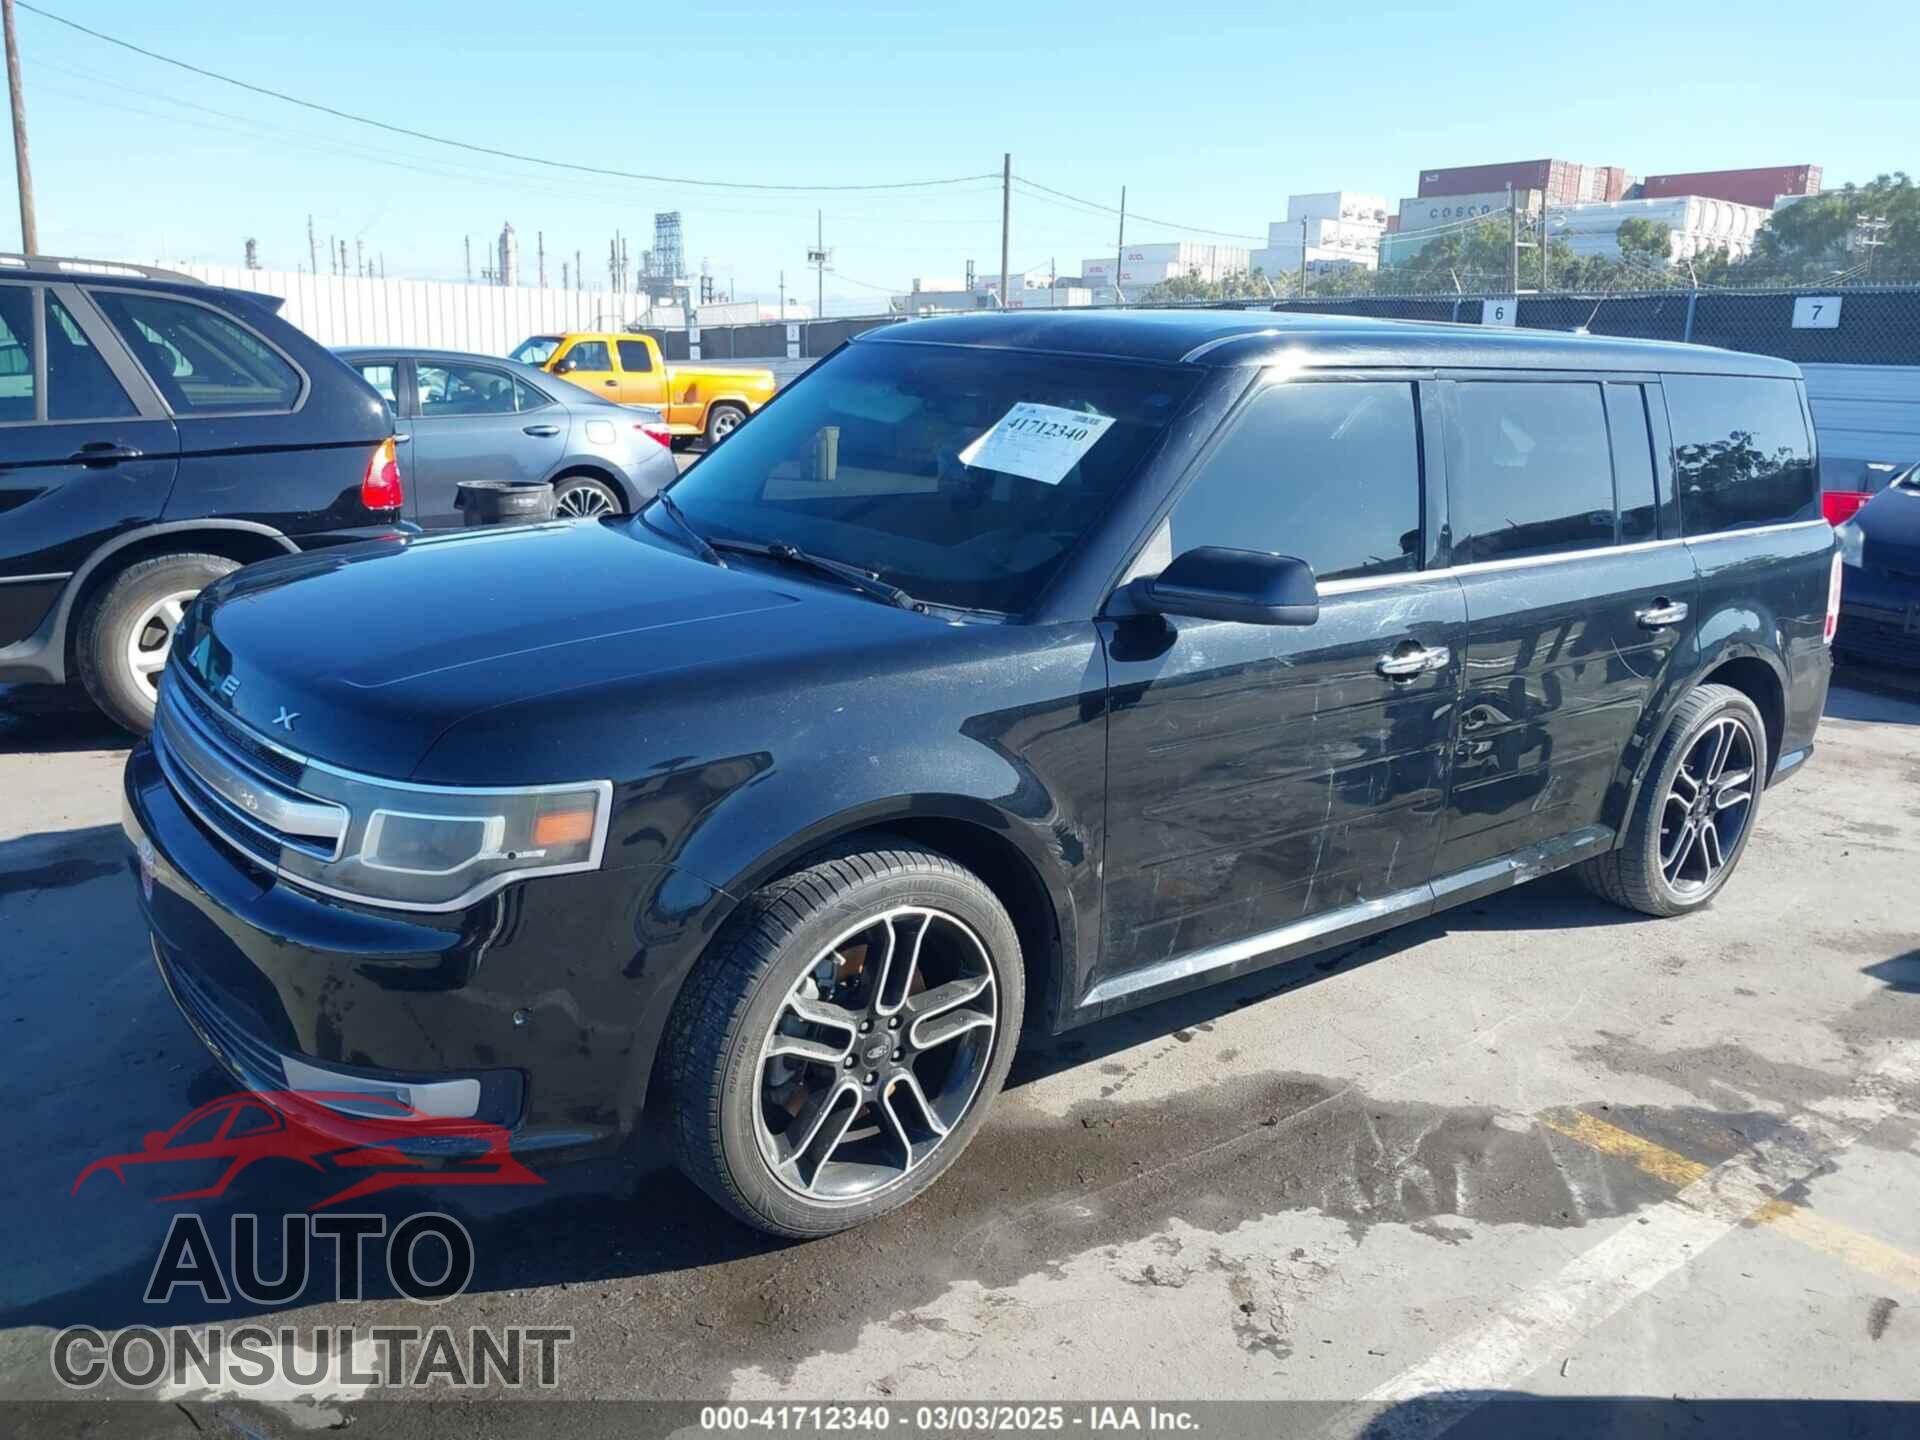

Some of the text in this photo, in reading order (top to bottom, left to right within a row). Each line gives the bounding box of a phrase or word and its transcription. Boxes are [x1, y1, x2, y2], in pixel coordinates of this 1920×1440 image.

[1430, 205, 1490, 219] COSCO
[1495, 306, 1504, 321] 6
[1812, 305, 1823, 320] 7
[1008, 417, 1088, 441] 41712340
